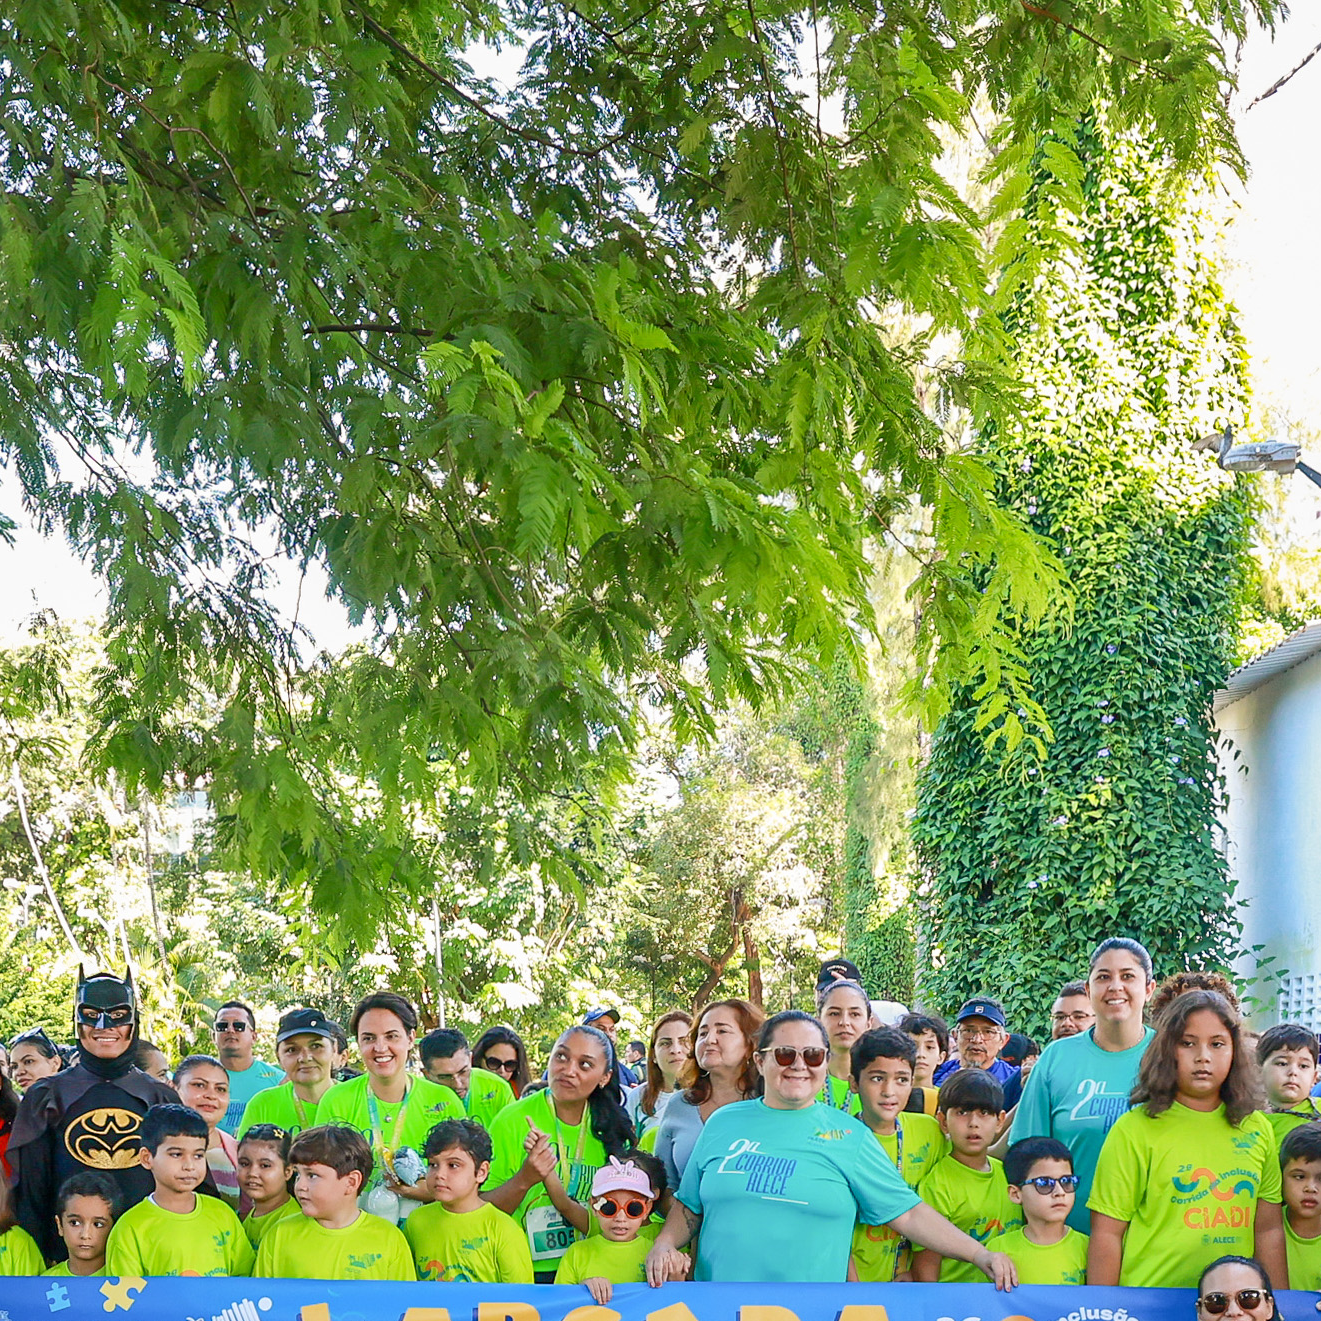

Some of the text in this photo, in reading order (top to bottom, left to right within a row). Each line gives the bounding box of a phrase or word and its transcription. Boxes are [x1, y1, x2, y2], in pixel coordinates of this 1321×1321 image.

[735, 1153, 797, 1177] CORRIDA
[745, 1171, 790, 1196] ALECE
[1170, 1189, 1209, 1205] Corrida
[1184, 1206, 1251, 1230] CIADI
[1212, 1236, 1236, 1244] ALECE
